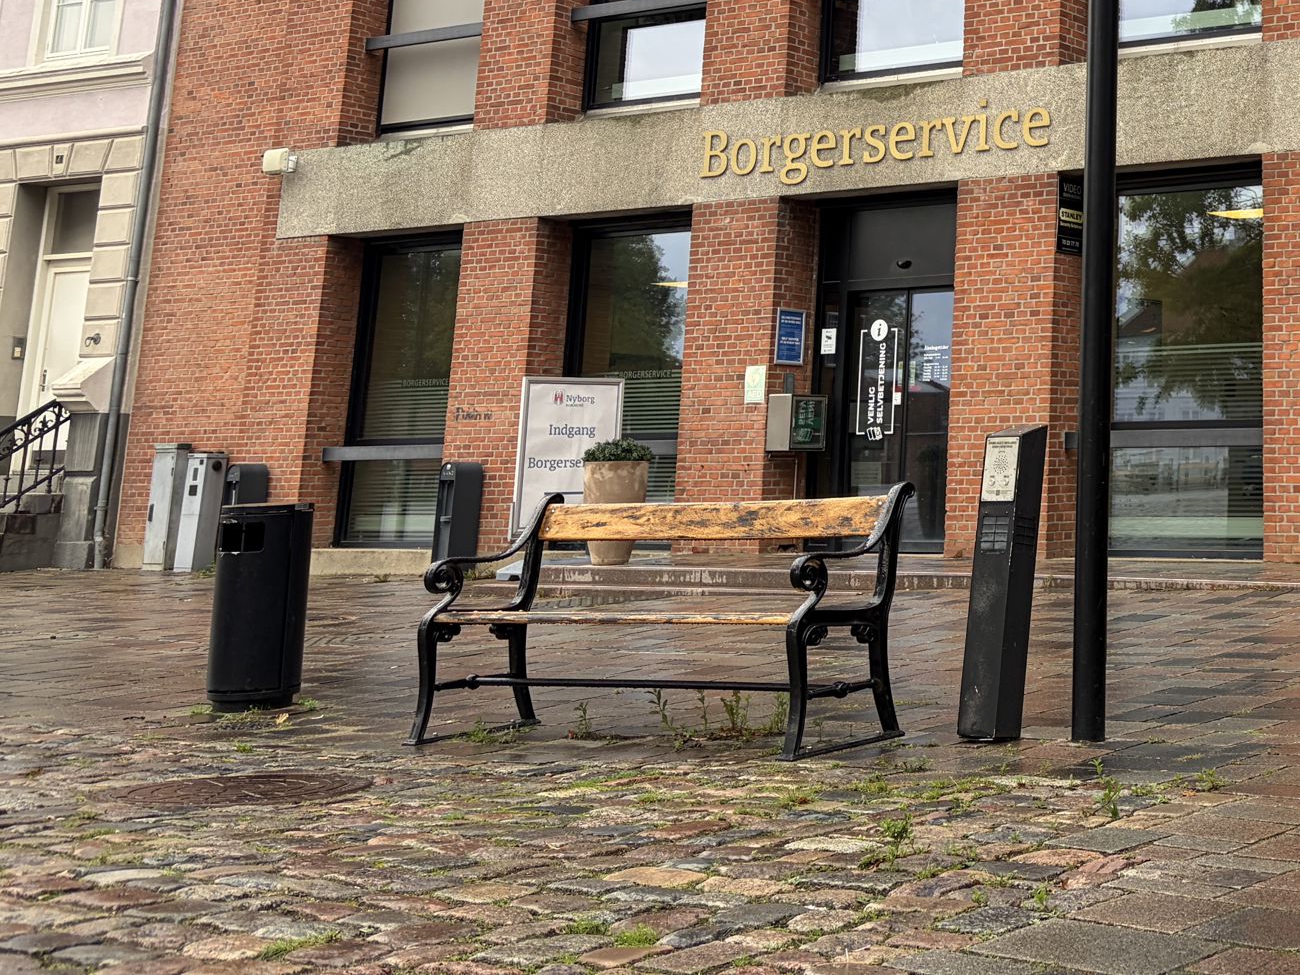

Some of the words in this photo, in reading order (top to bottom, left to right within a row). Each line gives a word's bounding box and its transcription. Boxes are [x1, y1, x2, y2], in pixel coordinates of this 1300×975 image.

[701, 99, 1051, 185] Borgerservice
[1063, 183, 1082, 195] VIDEO
[1061, 211, 1083, 222] STANLEY
[620, 369, 671, 378] BORGERSERVICE
[402, 378, 449, 386] BORGERSERVICE
[876, 342, 887, 424] SELVBETJENING
[566, 394, 596, 405] Nyborg
[867, 387, 876, 424] VENLIG
[548, 423, 597, 439] Indgang
